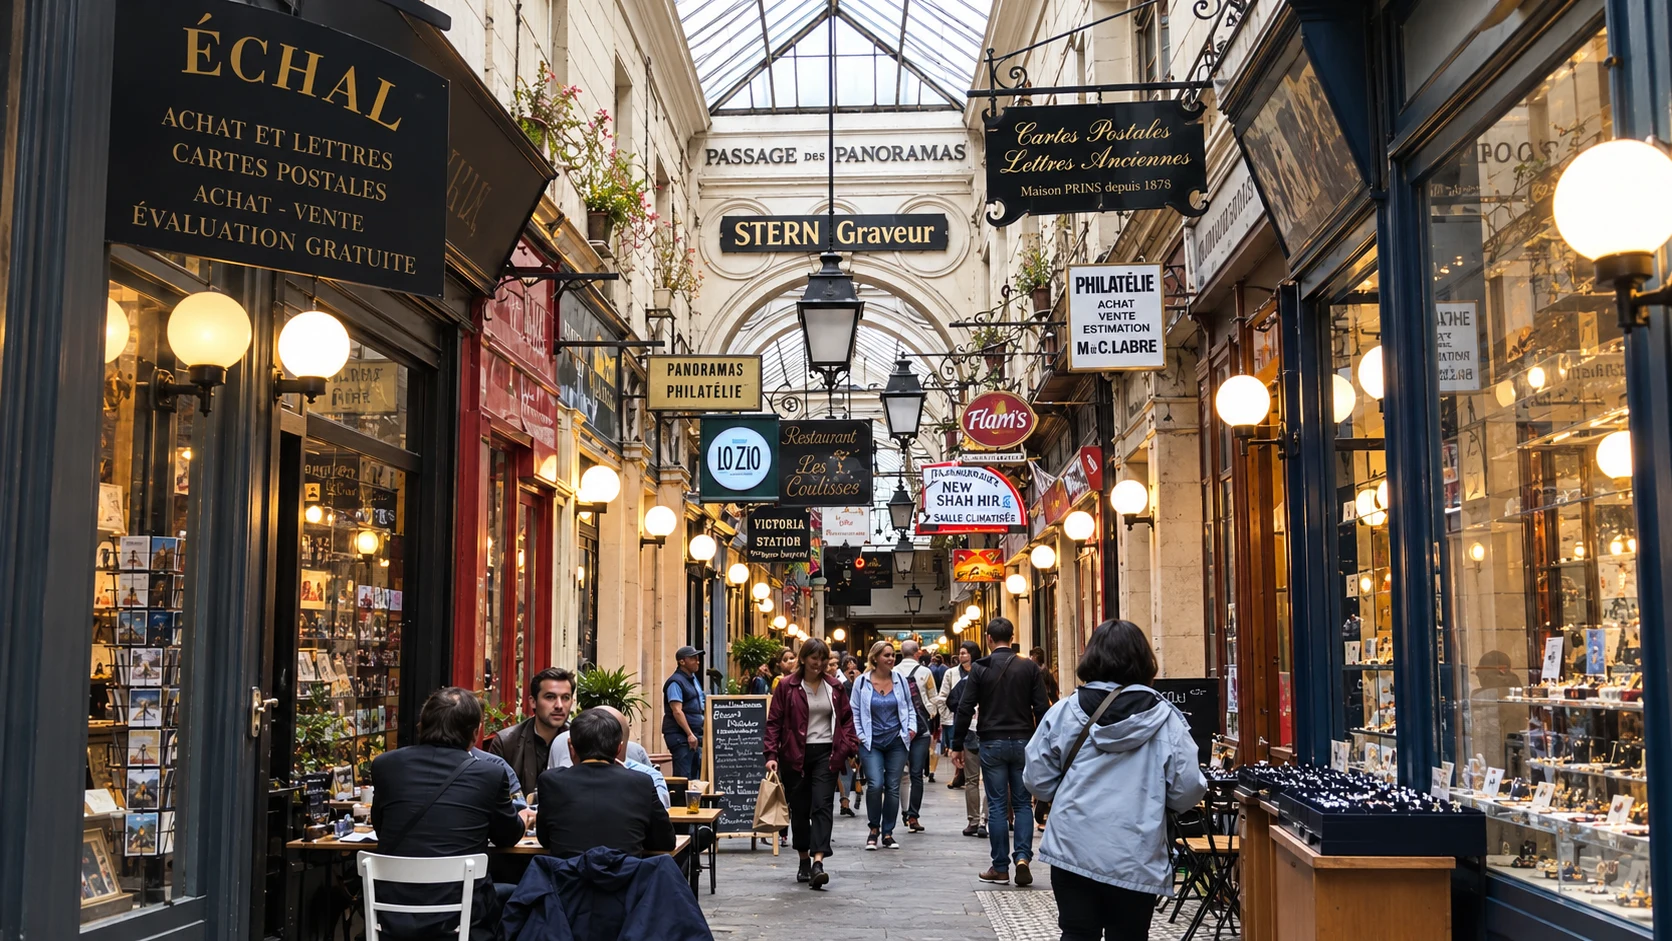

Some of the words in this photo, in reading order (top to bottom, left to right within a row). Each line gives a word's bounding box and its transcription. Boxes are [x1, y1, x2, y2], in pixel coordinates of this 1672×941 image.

[181, 12, 403, 132] ÉCHAL
[161, 107, 247, 140] ACHAT
[255, 125, 286, 148] ET
[293, 132, 394, 171] LETTRES
[1014, 121, 1079, 146] Cartes
[1086, 118, 1172, 143] Postales
[705, 147, 798, 166] PASSAGE
[834, 143, 967, 163] PANORAMAS
[999, 149, 1075, 174] Lettres
[1081, 145, 1193, 171] Anciennes
[172, 143, 268, 178] CARTES
[276, 162, 388, 202] POSTALES
[1020, 185, 1061, 197] Maison
[1065, 182, 1101, 194] PRINS
[1105, 181, 1141, 194] depuis
[1144, 179, 1171, 191] 1878
[193, 185, 272, 215] ACHAT
[293, 202, 364, 233] VENTE
[132, 201, 297, 251] ÉVALUATION
[305, 236, 417, 275] GRATUITE
[734, 221, 820, 246] STERN
[836, 220, 935, 245] Graveur
[1075, 272, 1155, 294] PHILATÉLIE
[1097, 299, 1135, 309] ACHAT
[1098, 311, 1136, 321] VENTE
[1083, 323, 1150, 334] ESTIMATION
[667, 363, 744, 376] PANORAMAS
[667, 381, 742, 398] PHILATÉLIE
[781, 426, 857, 445] Restaurant
[717, 446, 733, 470] LO
[795, 454, 827, 475] Les
[786, 475, 860, 497] Coulisses
[942, 481, 973, 493] NEW
[936, 494, 973, 507] SHAH
[977, 494, 1001, 507] HIR
